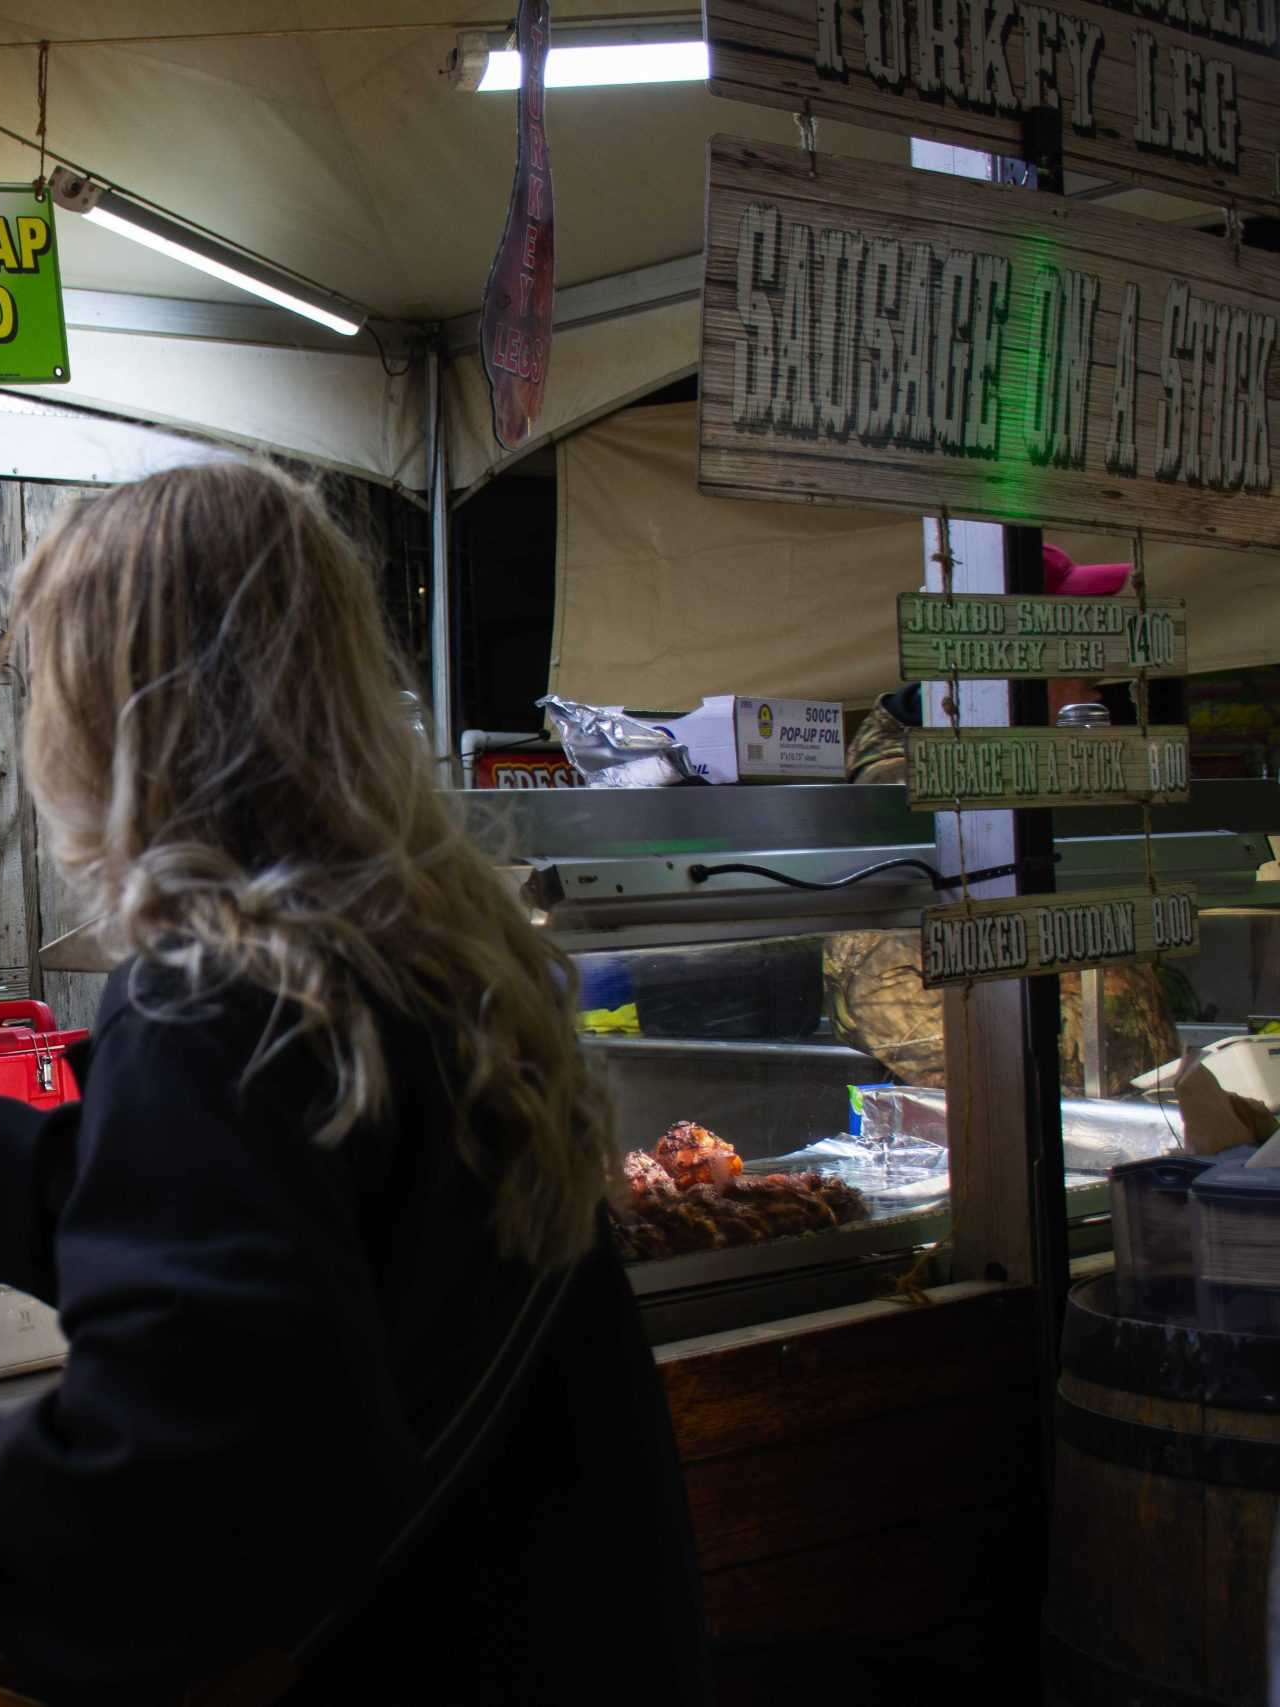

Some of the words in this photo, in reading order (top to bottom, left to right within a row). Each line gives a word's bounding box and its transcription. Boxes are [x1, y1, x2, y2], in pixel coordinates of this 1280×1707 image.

[1131, 30, 1237, 168] LEG
[732, 201, 1011, 458] SAUSAGE
[1025, 265, 1099, 468] ON
[1105, 281, 1140, 477] A
[1154, 278, 1279, 495] STICK
[907, 599, 1005, 634] JUMBO
[1018, 600, 1124, 634] SMOKED
[931, 637, 1046, 673] TURKEY
[1058, 639, 1105, 672] LEG
[780, 726, 817, 741] POP-UP
[819, 729, 840, 744] FOIL
[805, 707, 840, 723] 500CT
[914, 740, 1004, 795] SAUSAGE
[1011, 741, 1040, 794] ON
[1048, 741, 1062, 793] A
[1069, 740, 1127, 793] STICK
[1148, 741, 1188, 792] 8.00
[928, 912, 1029, 978] SMOKED
[1037, 902, 1136, 966] BOUDAN
[1151, 893, 1193, 949] 8.00
